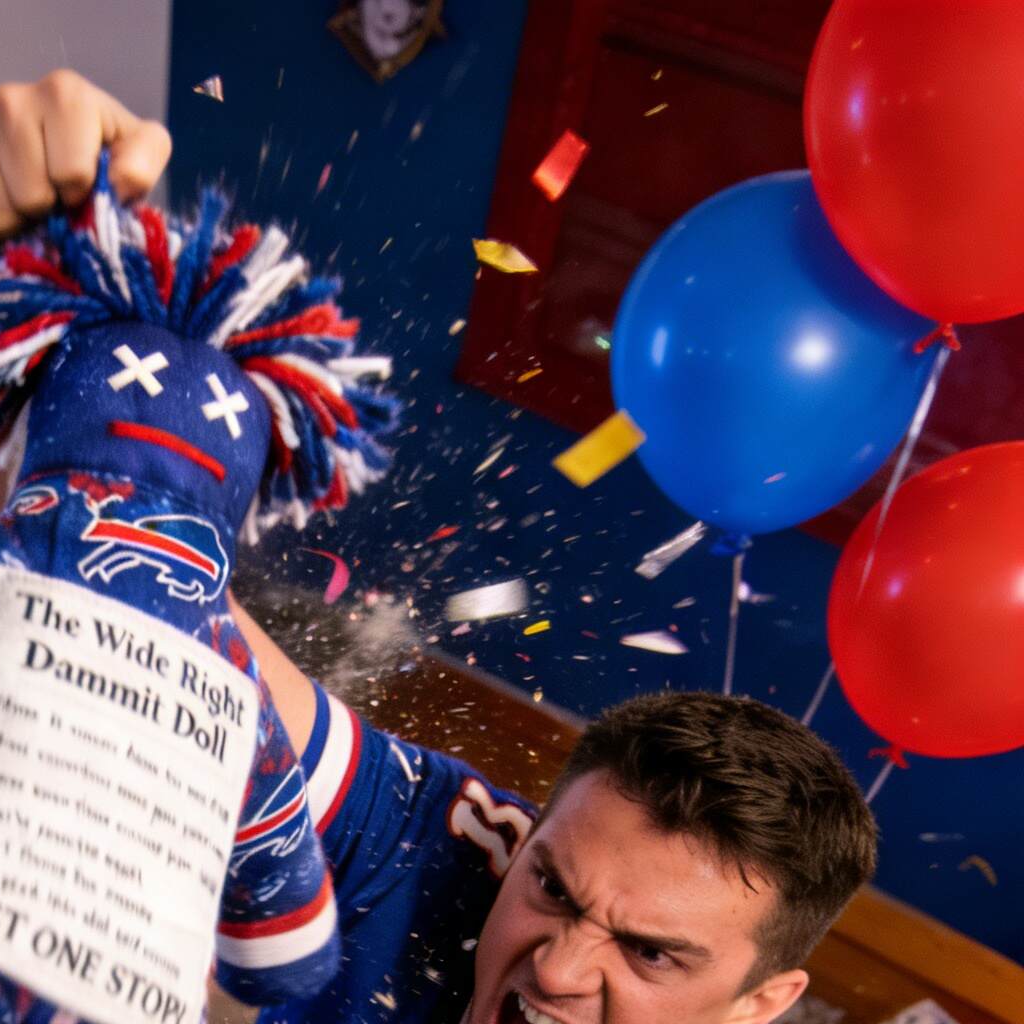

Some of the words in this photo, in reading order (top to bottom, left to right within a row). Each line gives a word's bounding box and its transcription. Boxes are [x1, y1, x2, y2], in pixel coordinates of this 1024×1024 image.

[17, 590, 80, 637] The
[94, 618, 169, 677] Wide
[181, 658, 245, 727] Right
[22, 639, 165, 725] Dammit
[173, 702, 228, 763] Doll
[32, 926, 104, 984] ONE
